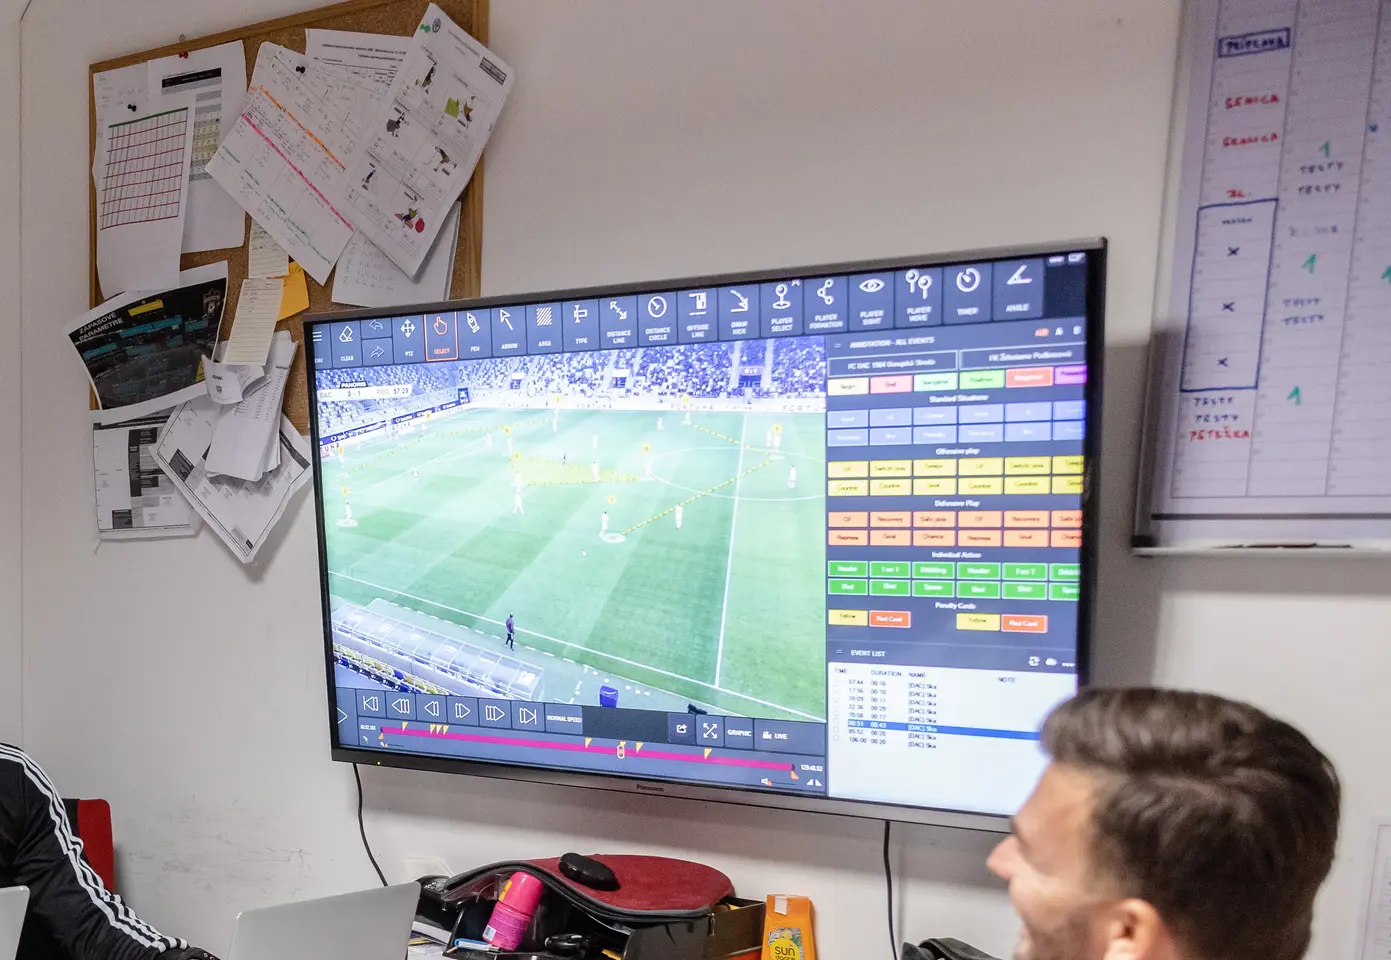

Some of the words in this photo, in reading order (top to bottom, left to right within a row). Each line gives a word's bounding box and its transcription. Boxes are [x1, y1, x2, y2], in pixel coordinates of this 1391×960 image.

[771, 317, 793, 325] PLAYER
[78, 317, 124, 341] PARAMETRE
[771, 324, 793, 332] SELECT
[850, 649, 871, 657] EVENT
[872, 650, 886, 658] LIST
[566, 716, 582, 724] SPEED
[727, 728, 752, 737] GRAPHIC
[774, 732, 788, 740] LIVE
[774, 946, 796, 957] sun
